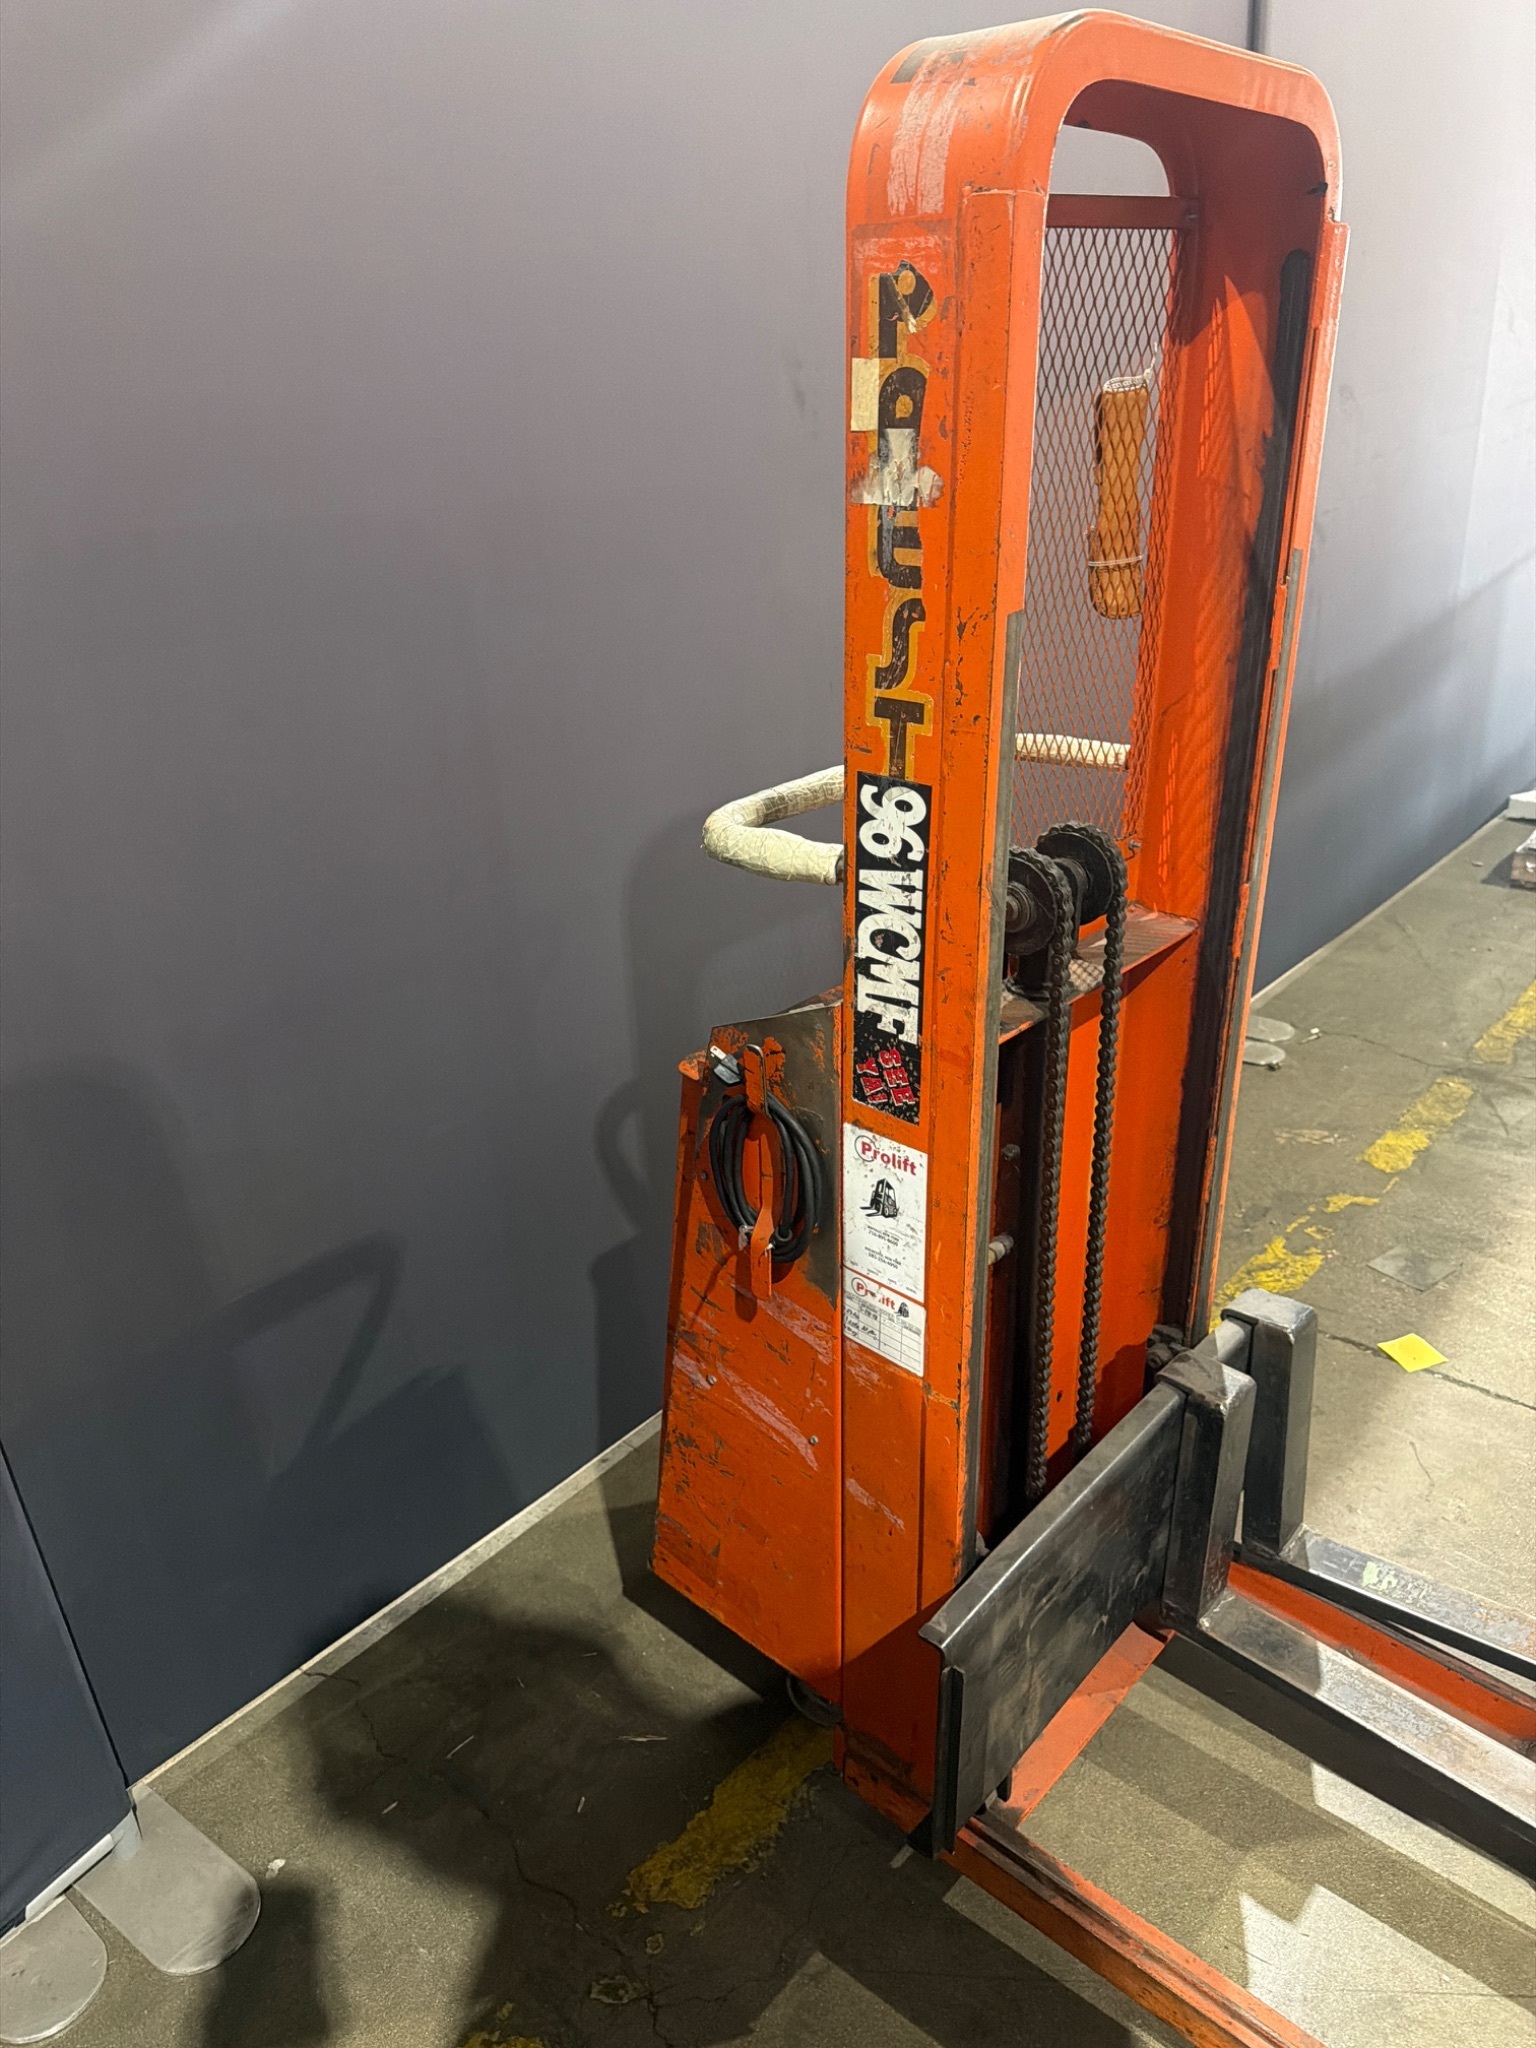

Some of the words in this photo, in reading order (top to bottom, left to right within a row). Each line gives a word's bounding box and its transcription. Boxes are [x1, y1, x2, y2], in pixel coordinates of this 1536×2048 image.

[859, 784, 927, 861] 96
[857, 869, 924, 1044] WCMF
[856, 1057, 888, 1103] YA!
[879, 1049, 915, 1106] SEE
[861, 1141, 916, 1176] Prolift
